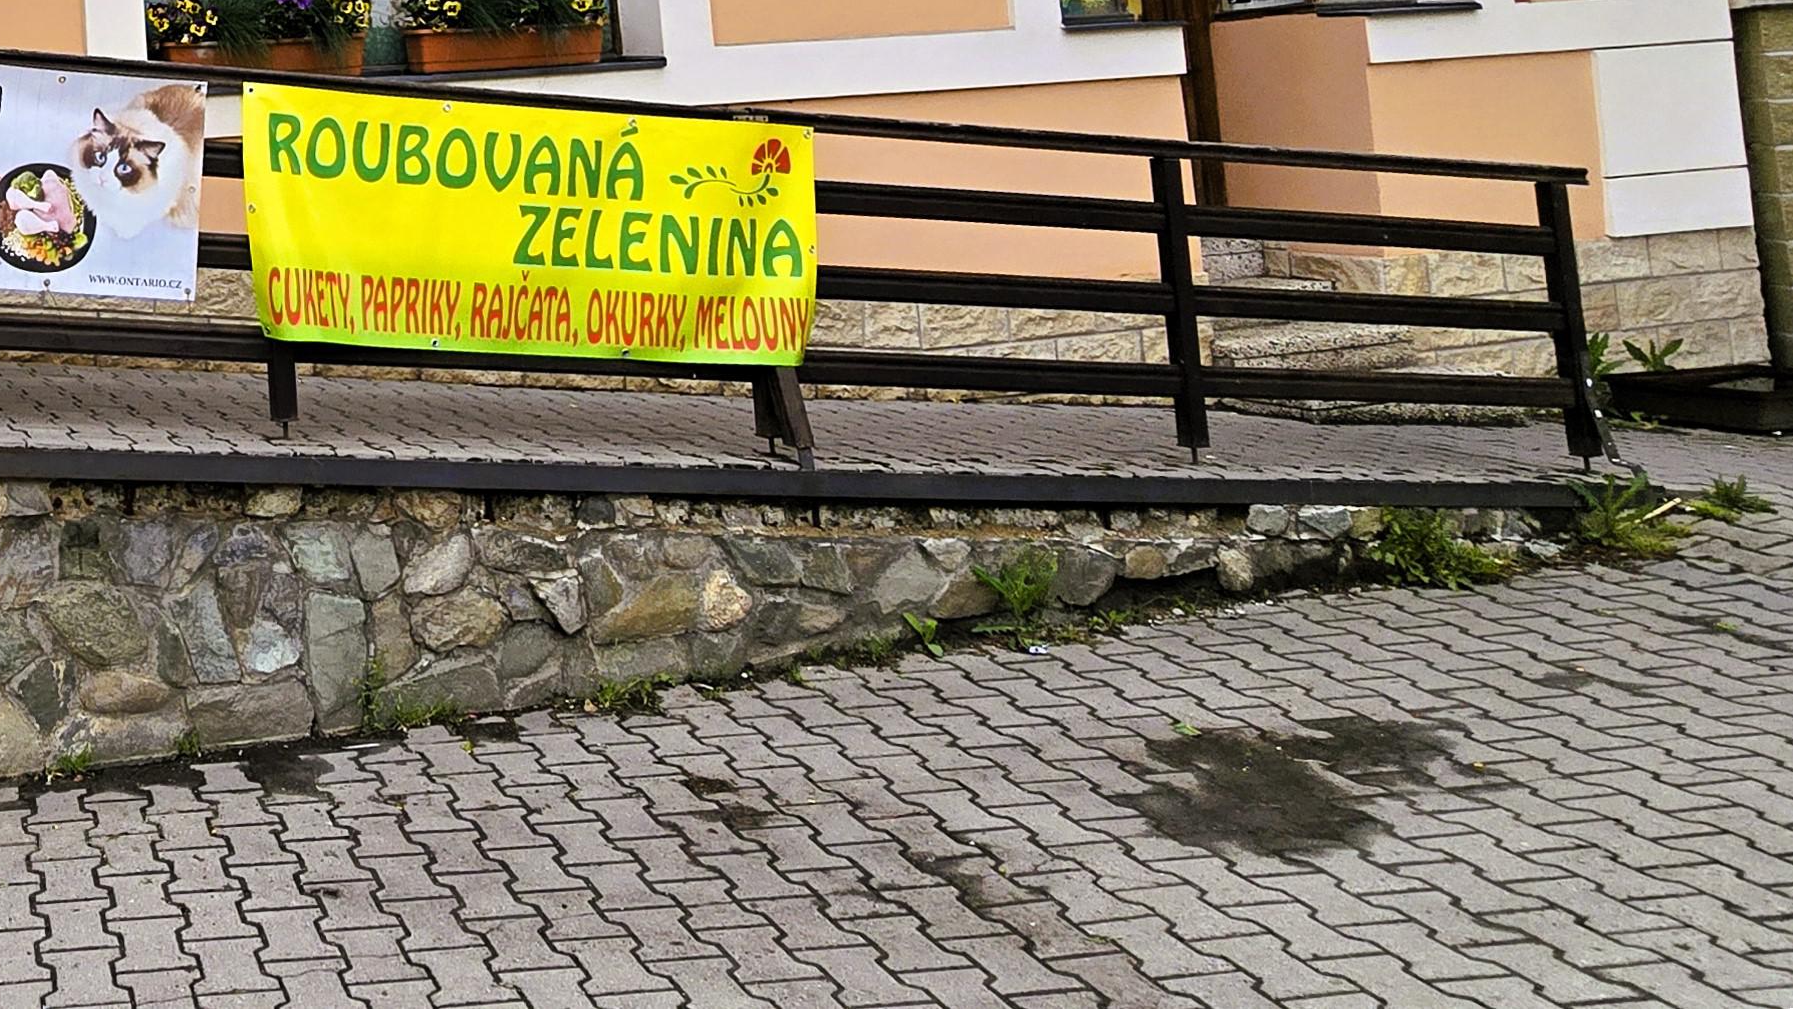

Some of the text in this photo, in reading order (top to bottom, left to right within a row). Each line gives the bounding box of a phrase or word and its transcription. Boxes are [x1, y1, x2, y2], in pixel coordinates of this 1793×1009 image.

[268, 112, 645, 201] ROUBOVANÁ
[512, 205, 803, 278] ZELENINA
[88, 274, 183, 289] WWW.ONTARIO.CZ
[267, 266, 809, 352] CUKETY, PAPRIKY, RAJČATA, OKURKY, MELOUNY
